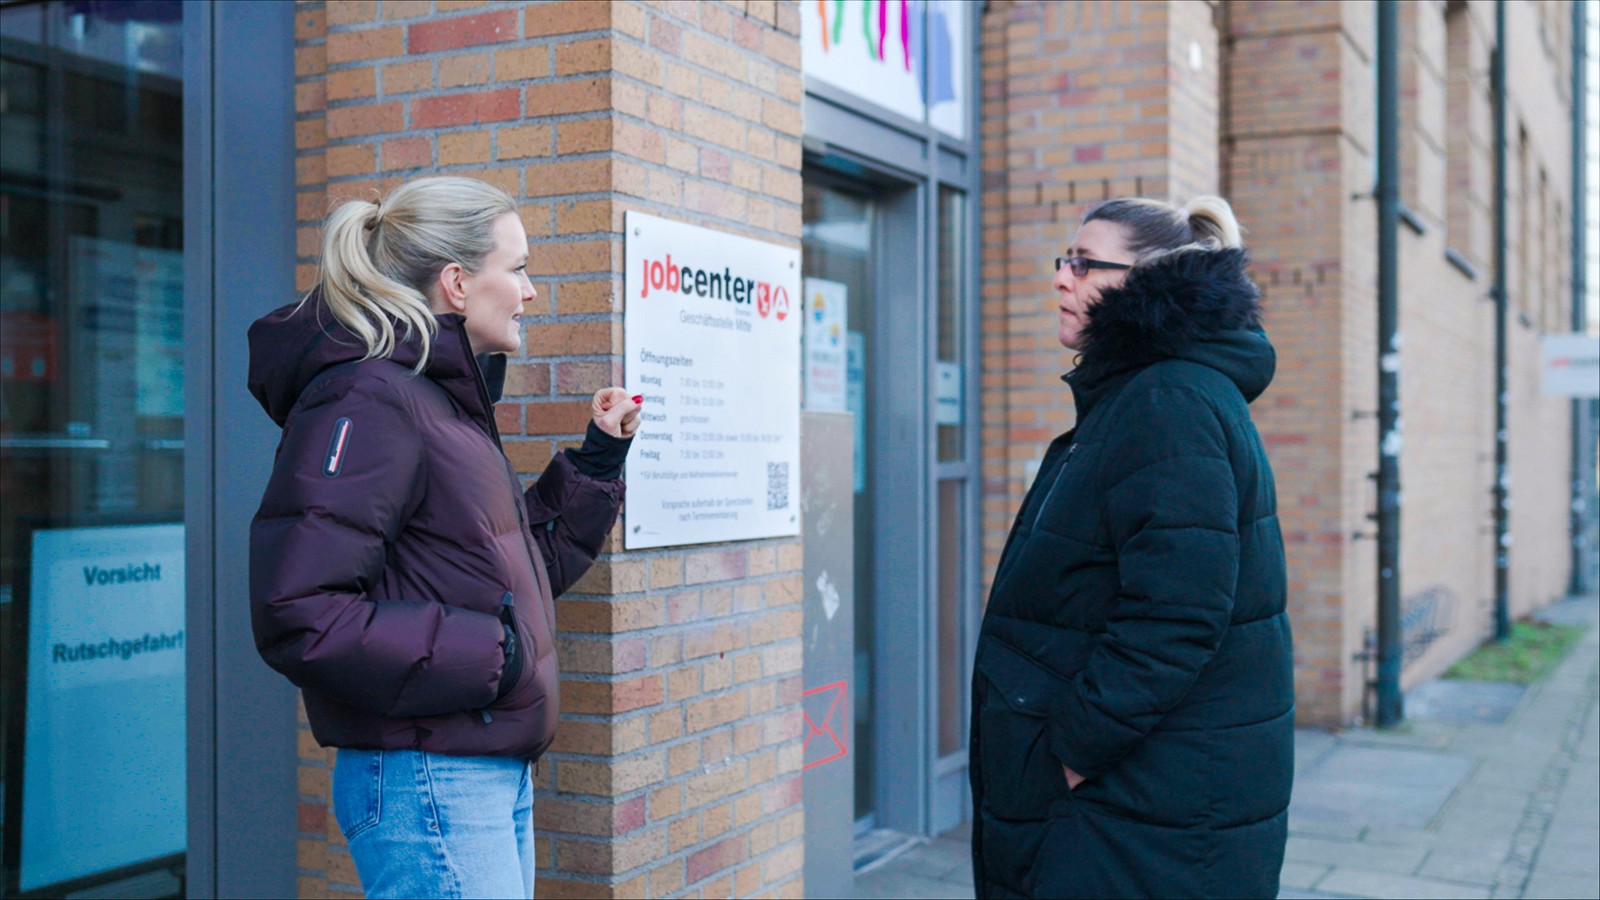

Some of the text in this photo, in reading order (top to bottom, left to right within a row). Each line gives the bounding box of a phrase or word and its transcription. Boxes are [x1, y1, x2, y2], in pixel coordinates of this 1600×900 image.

[641, 253, 755, 304] jobcenter
[640, 348, 693, 367] Öffnungszeiten
[640, 374, 662, 387] Montag
[641, 393, 665, 406] ienstag
[640, 411, 667, 422] Mittwoch
[640, 431, 672, 443] Donnerstag
[640, 449, 660, 461] Freitag
[83, 562, 161, 586] Vorsicht
[52, 630, 184, 664] Rutschgefahr!
